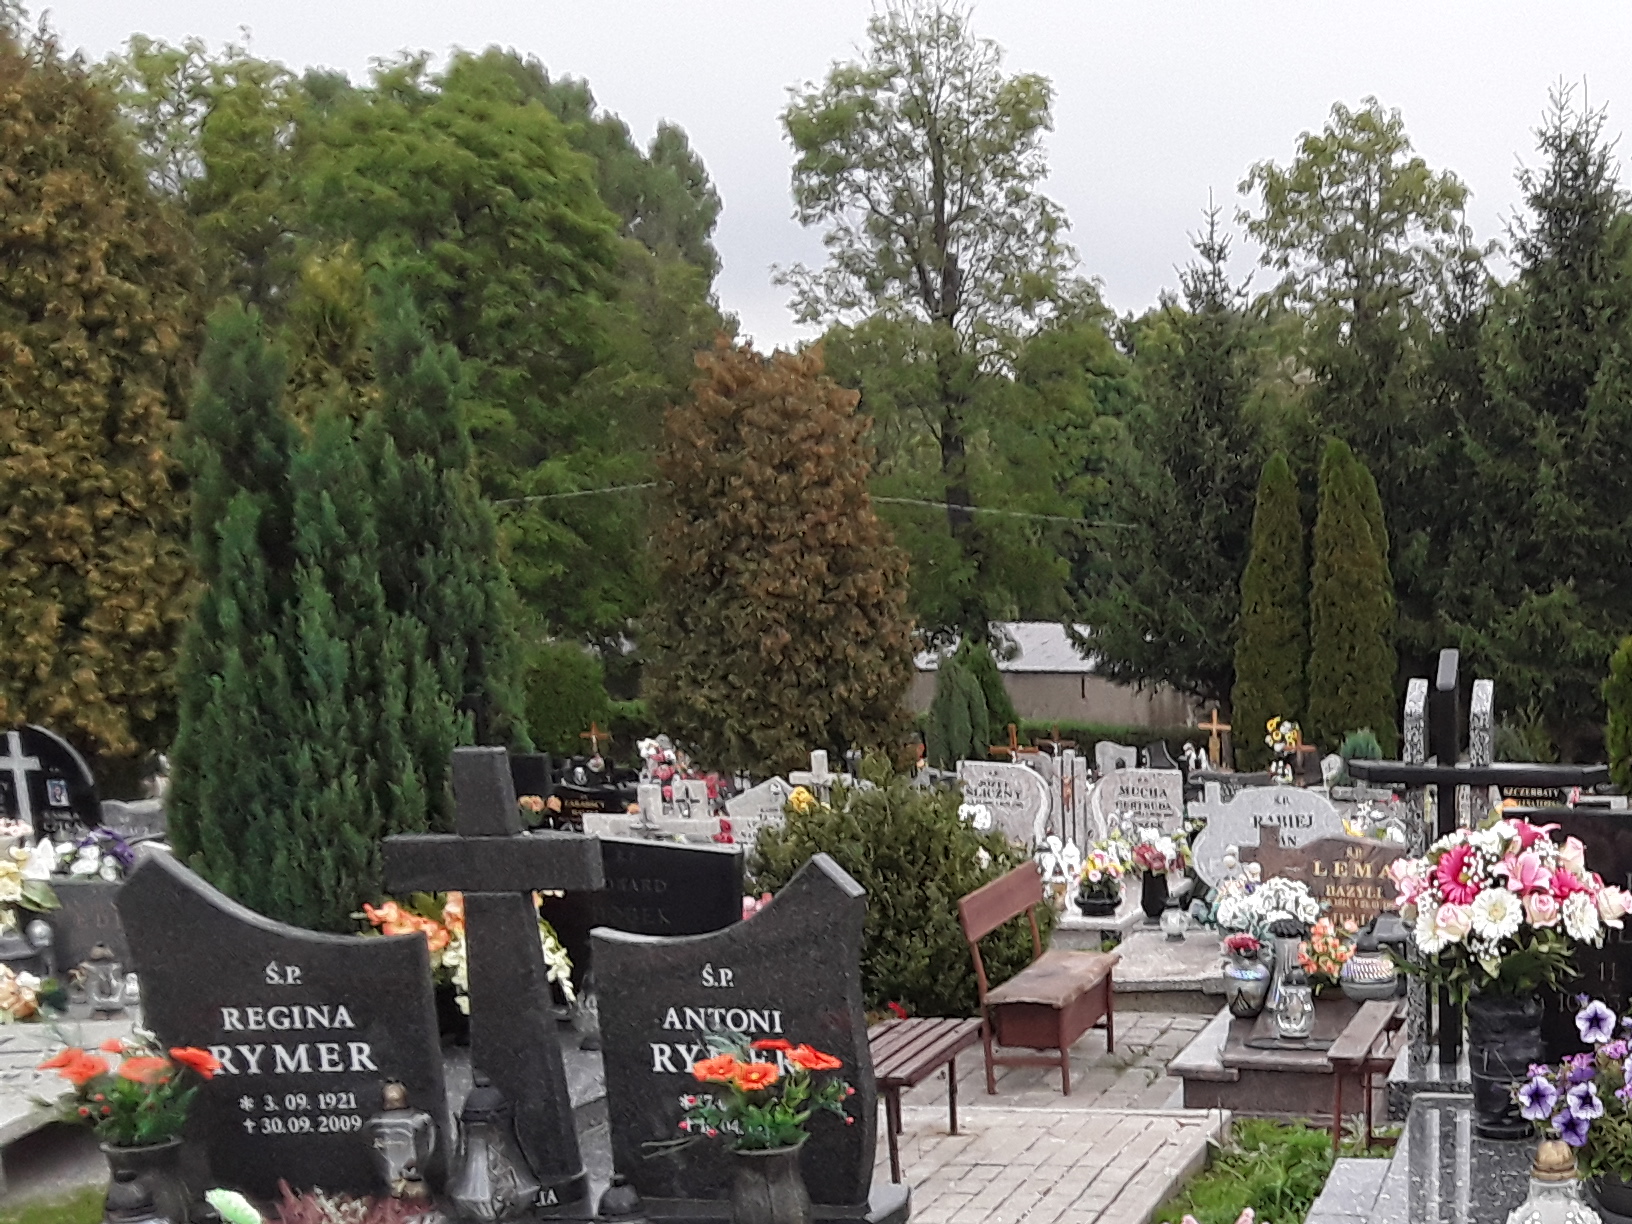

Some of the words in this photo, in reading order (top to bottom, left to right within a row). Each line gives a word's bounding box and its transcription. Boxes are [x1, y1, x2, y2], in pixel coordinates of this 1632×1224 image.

[220, 1005, 355, 1031] REGINA
[662, 1006, 785, 1034] ANTONI
[207, 1042, 379, 1076] RYMER
[317, 1092, 358, 1110] 1921
[318, 1115, 363, 1133] 2009
